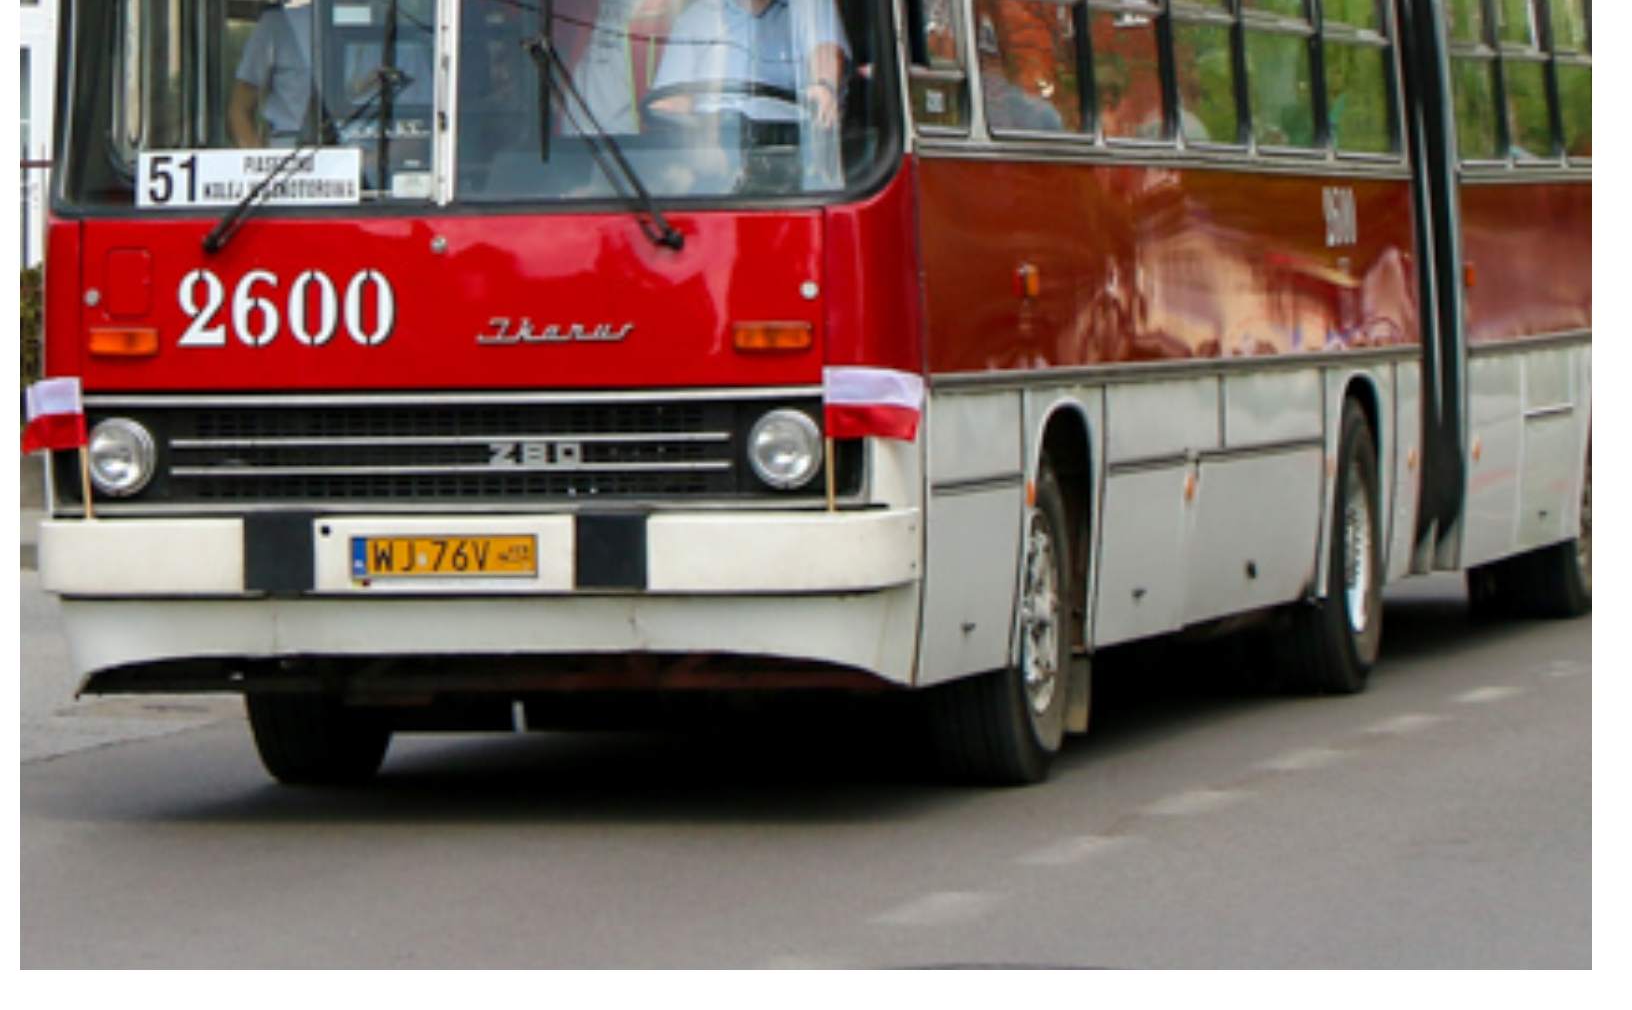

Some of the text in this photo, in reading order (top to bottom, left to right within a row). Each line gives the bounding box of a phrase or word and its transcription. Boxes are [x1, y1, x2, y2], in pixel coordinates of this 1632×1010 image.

[149, 155, 197, 204] 51
[176, 268, 396, 347] 2600
[475, 316, 635, 344] Ikarus
[373, 540, 490, 572] WJ 76V
